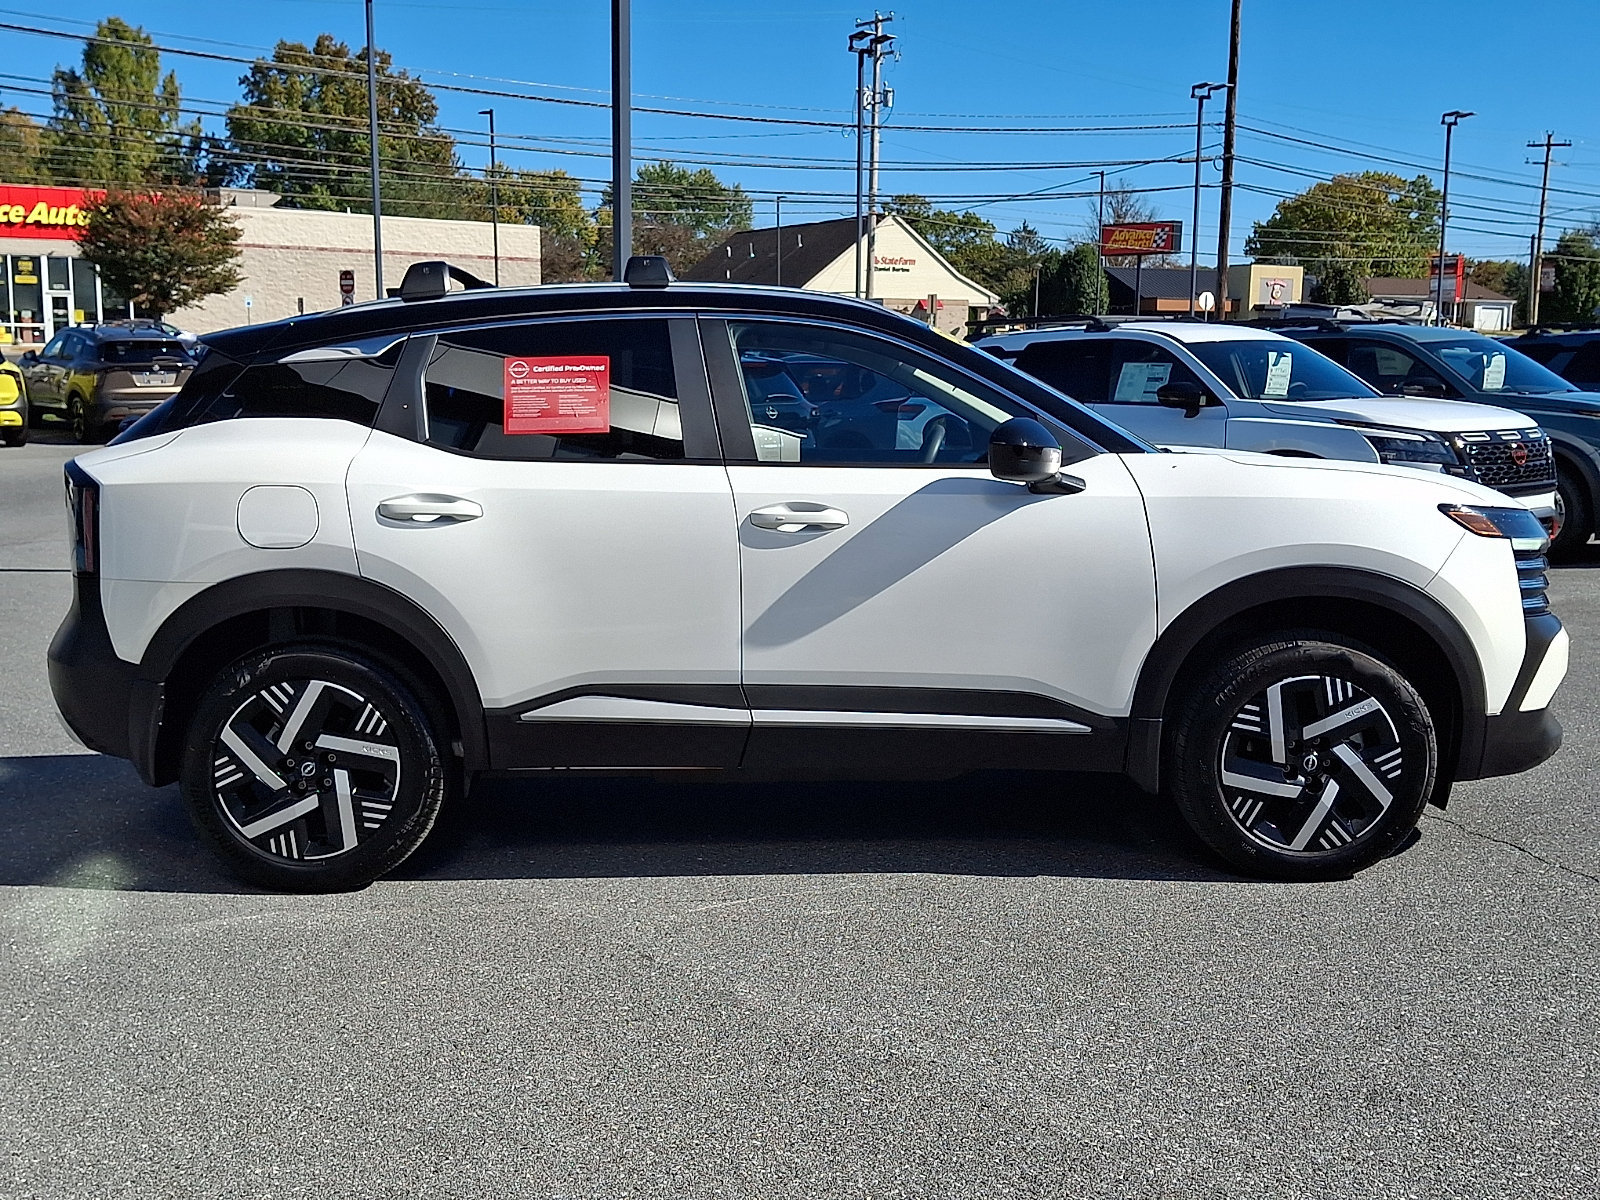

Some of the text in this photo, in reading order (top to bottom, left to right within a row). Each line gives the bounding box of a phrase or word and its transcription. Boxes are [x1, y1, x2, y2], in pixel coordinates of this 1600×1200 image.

[1109, 230, 1152, 242] Advance
[1106, 238, 1151, 249] Auto Parts
[532, 365, 564, 373] Certified
[1344, 703, 1373, 719] KICKS
[361, 745, 392, 756] KICKS
